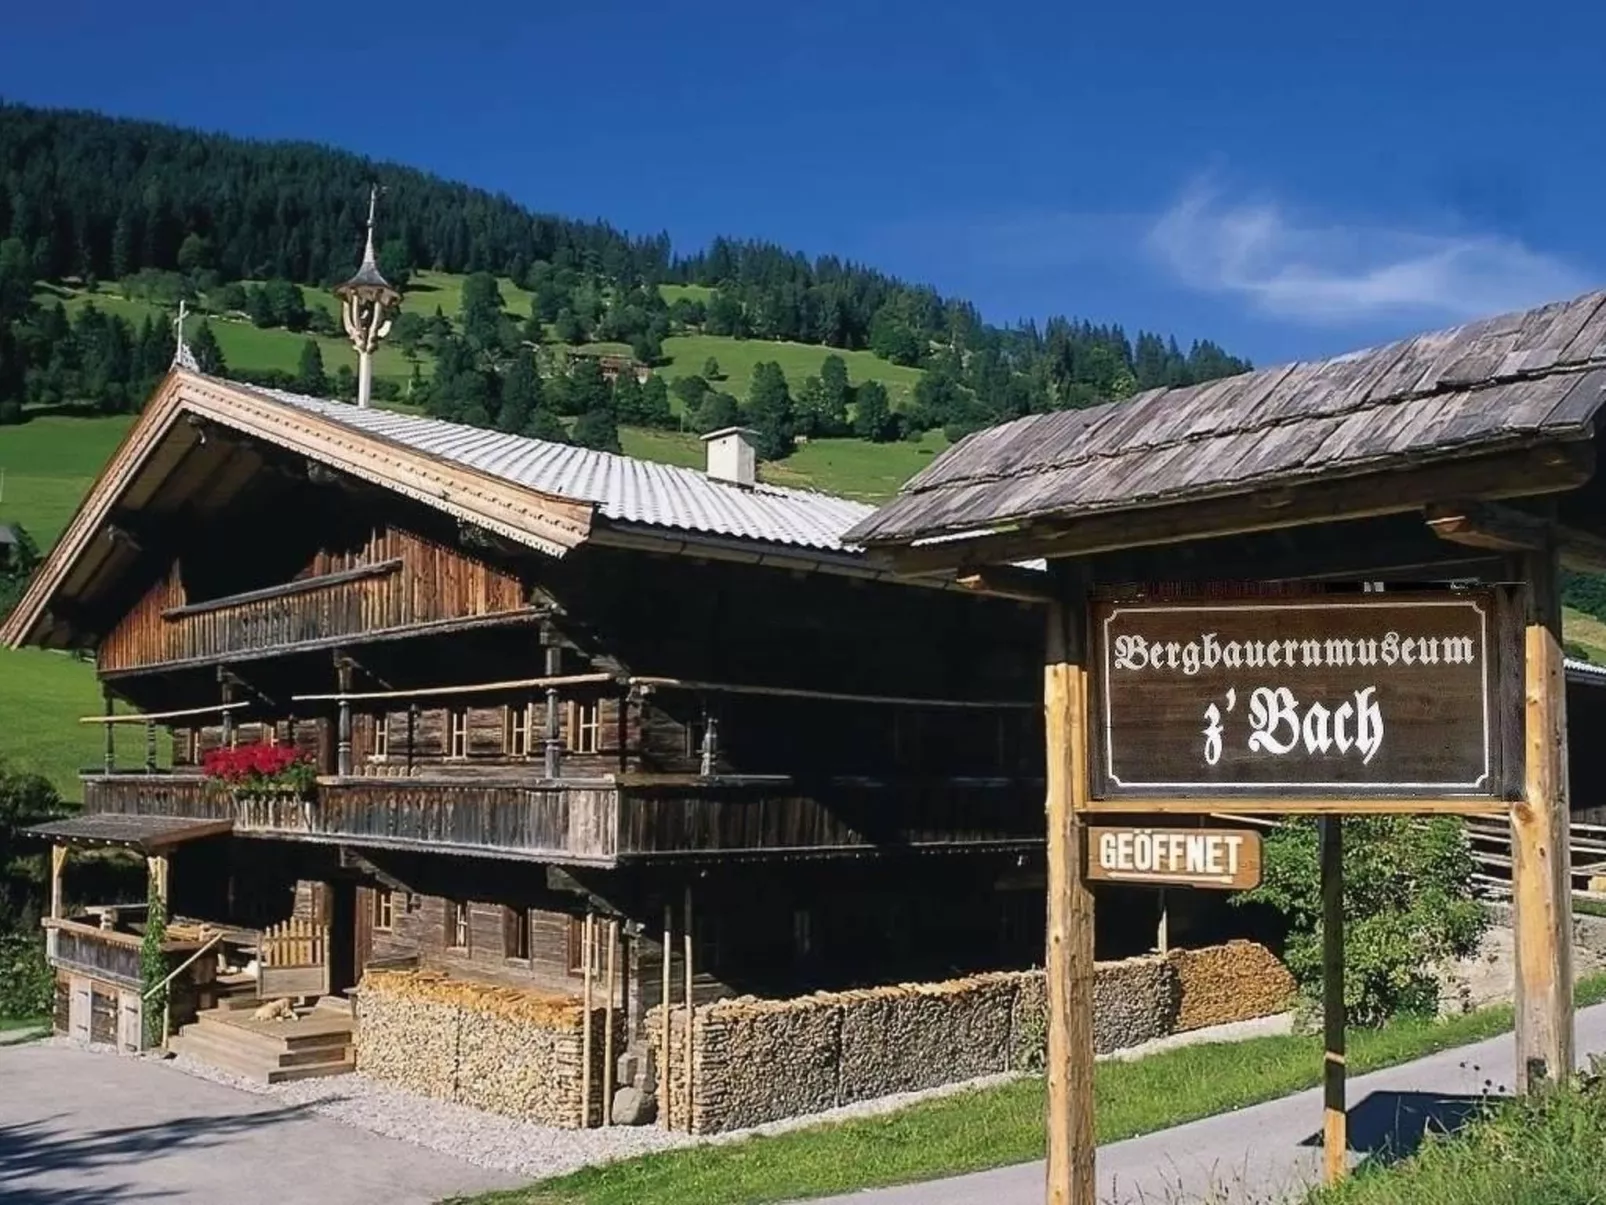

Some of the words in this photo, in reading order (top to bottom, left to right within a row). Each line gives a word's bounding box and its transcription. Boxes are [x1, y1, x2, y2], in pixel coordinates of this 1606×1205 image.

[1114, 632, 1475, 675] Bergbauernmuseum
[1247, 685, 1384, 766] Bach
[1098, 828, 1244, 875] GEÖFFNET
